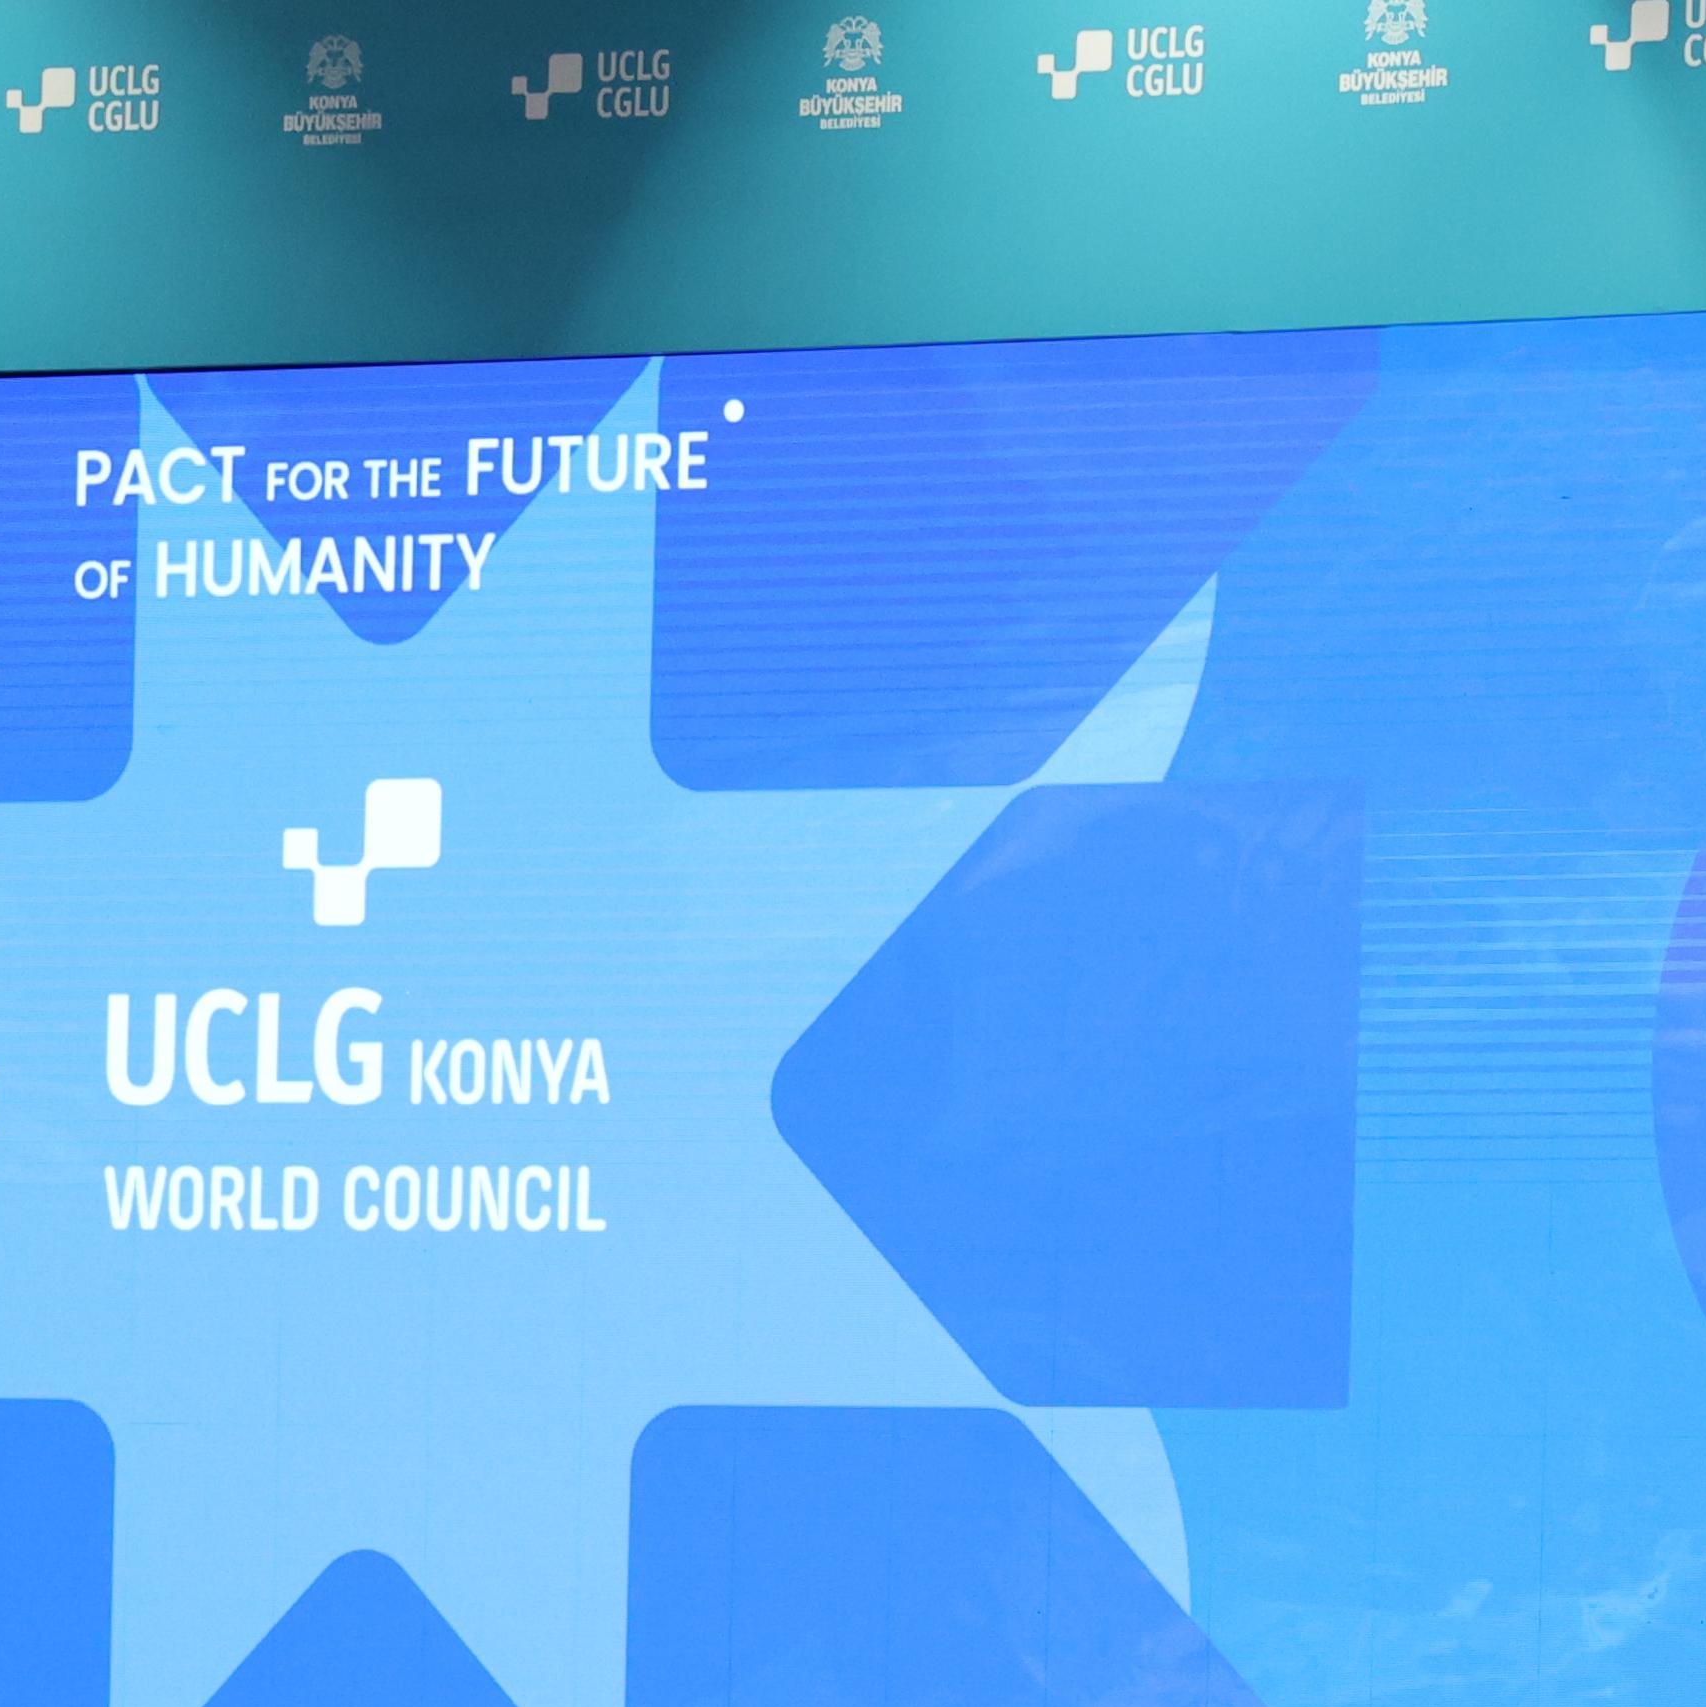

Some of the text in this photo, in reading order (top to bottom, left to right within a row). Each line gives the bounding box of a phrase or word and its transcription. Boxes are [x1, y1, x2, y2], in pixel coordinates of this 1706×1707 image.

[1128, 25, 1204, 60] UCLG
[598, 49, 670, 82] UCLG
[1368, 51, 1421, 68] KONYA
[89, 65, 159, 96] UCLG
[827, 78, 880, 93] KONYA
[1127, 63, 1203, 97] CGLU
[88, 101, 158, 132] CGLU
[309, 96, 357, 109] KONYA
[597, 86, 669, 118] CGLU
[77, 432, 708, 506] PACT FOR THE FUTURE
[75, 533, 495, 599] OF HUMANITY
[107, 988, 610, 1105] UCLG KONYA
[105, 1166, 606, 1231] WORLD COUNCIL
